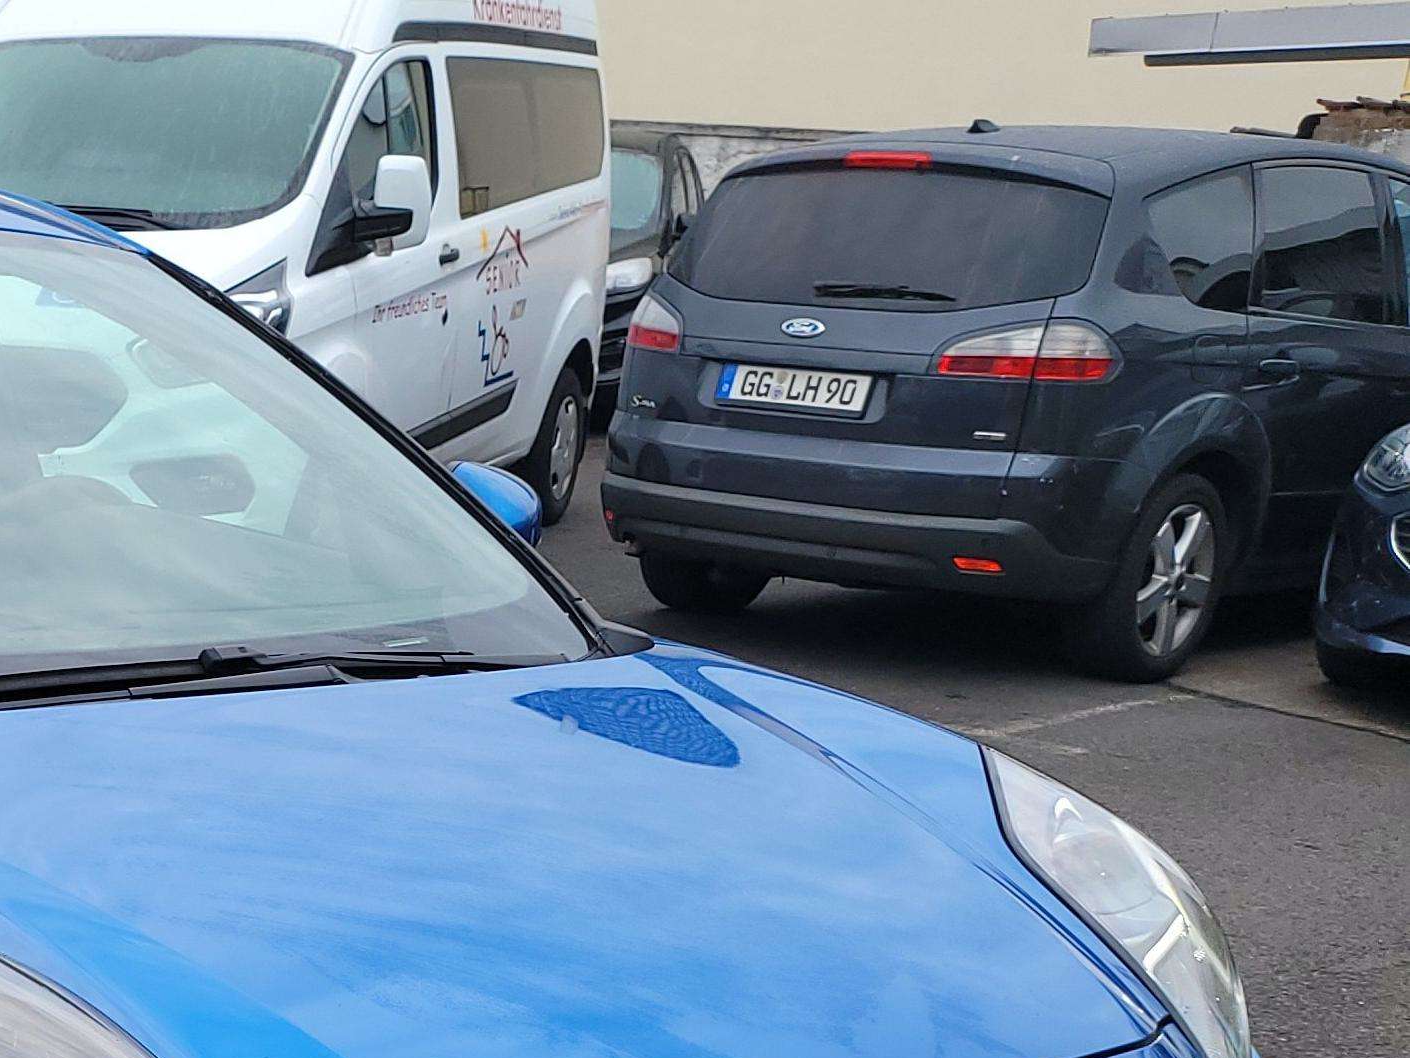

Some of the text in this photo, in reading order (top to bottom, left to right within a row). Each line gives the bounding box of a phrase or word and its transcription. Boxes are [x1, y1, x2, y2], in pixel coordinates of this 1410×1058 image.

[741, 370, 858, 406] GG LH 90
